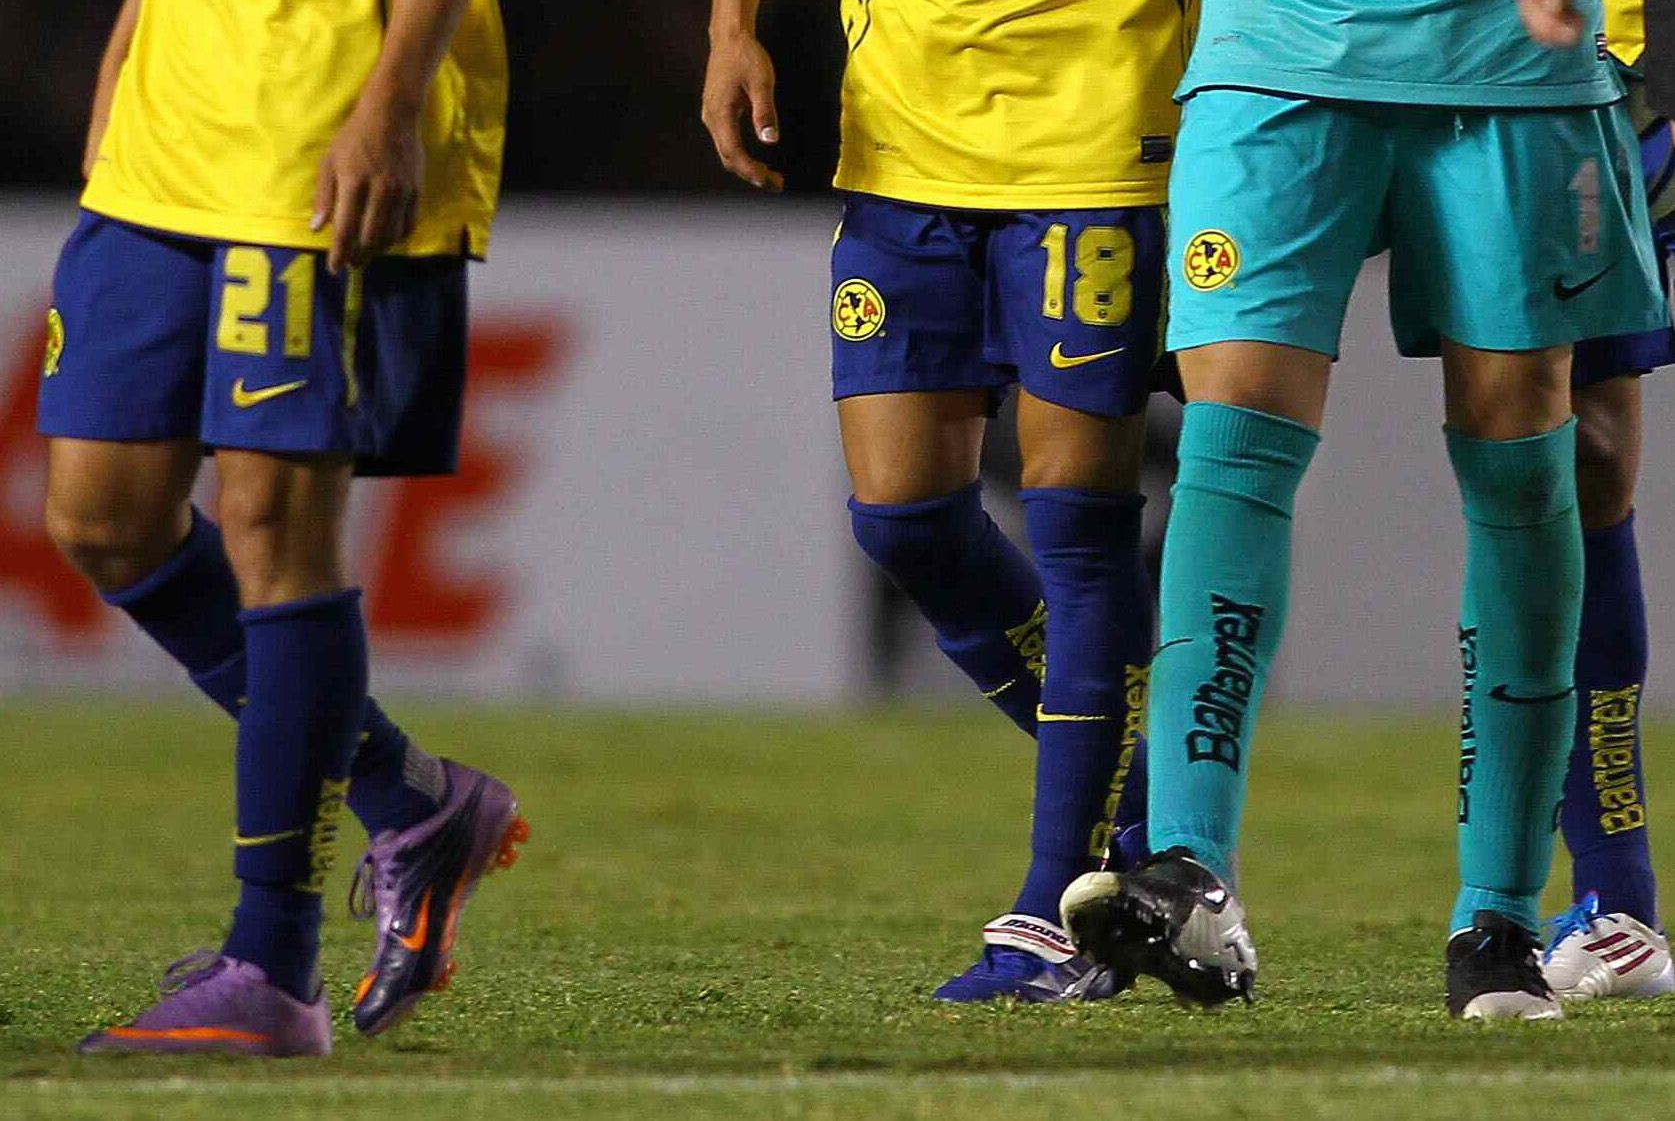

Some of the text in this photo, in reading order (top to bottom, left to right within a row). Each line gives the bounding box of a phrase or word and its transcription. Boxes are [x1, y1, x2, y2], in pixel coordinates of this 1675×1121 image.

[216, 246, 315, 359] 21
[1038, 223, 1135, 326] 18
[1187, 591, 1265, 775] Banamex
[1589, 684, 1645, 834] Banamex
